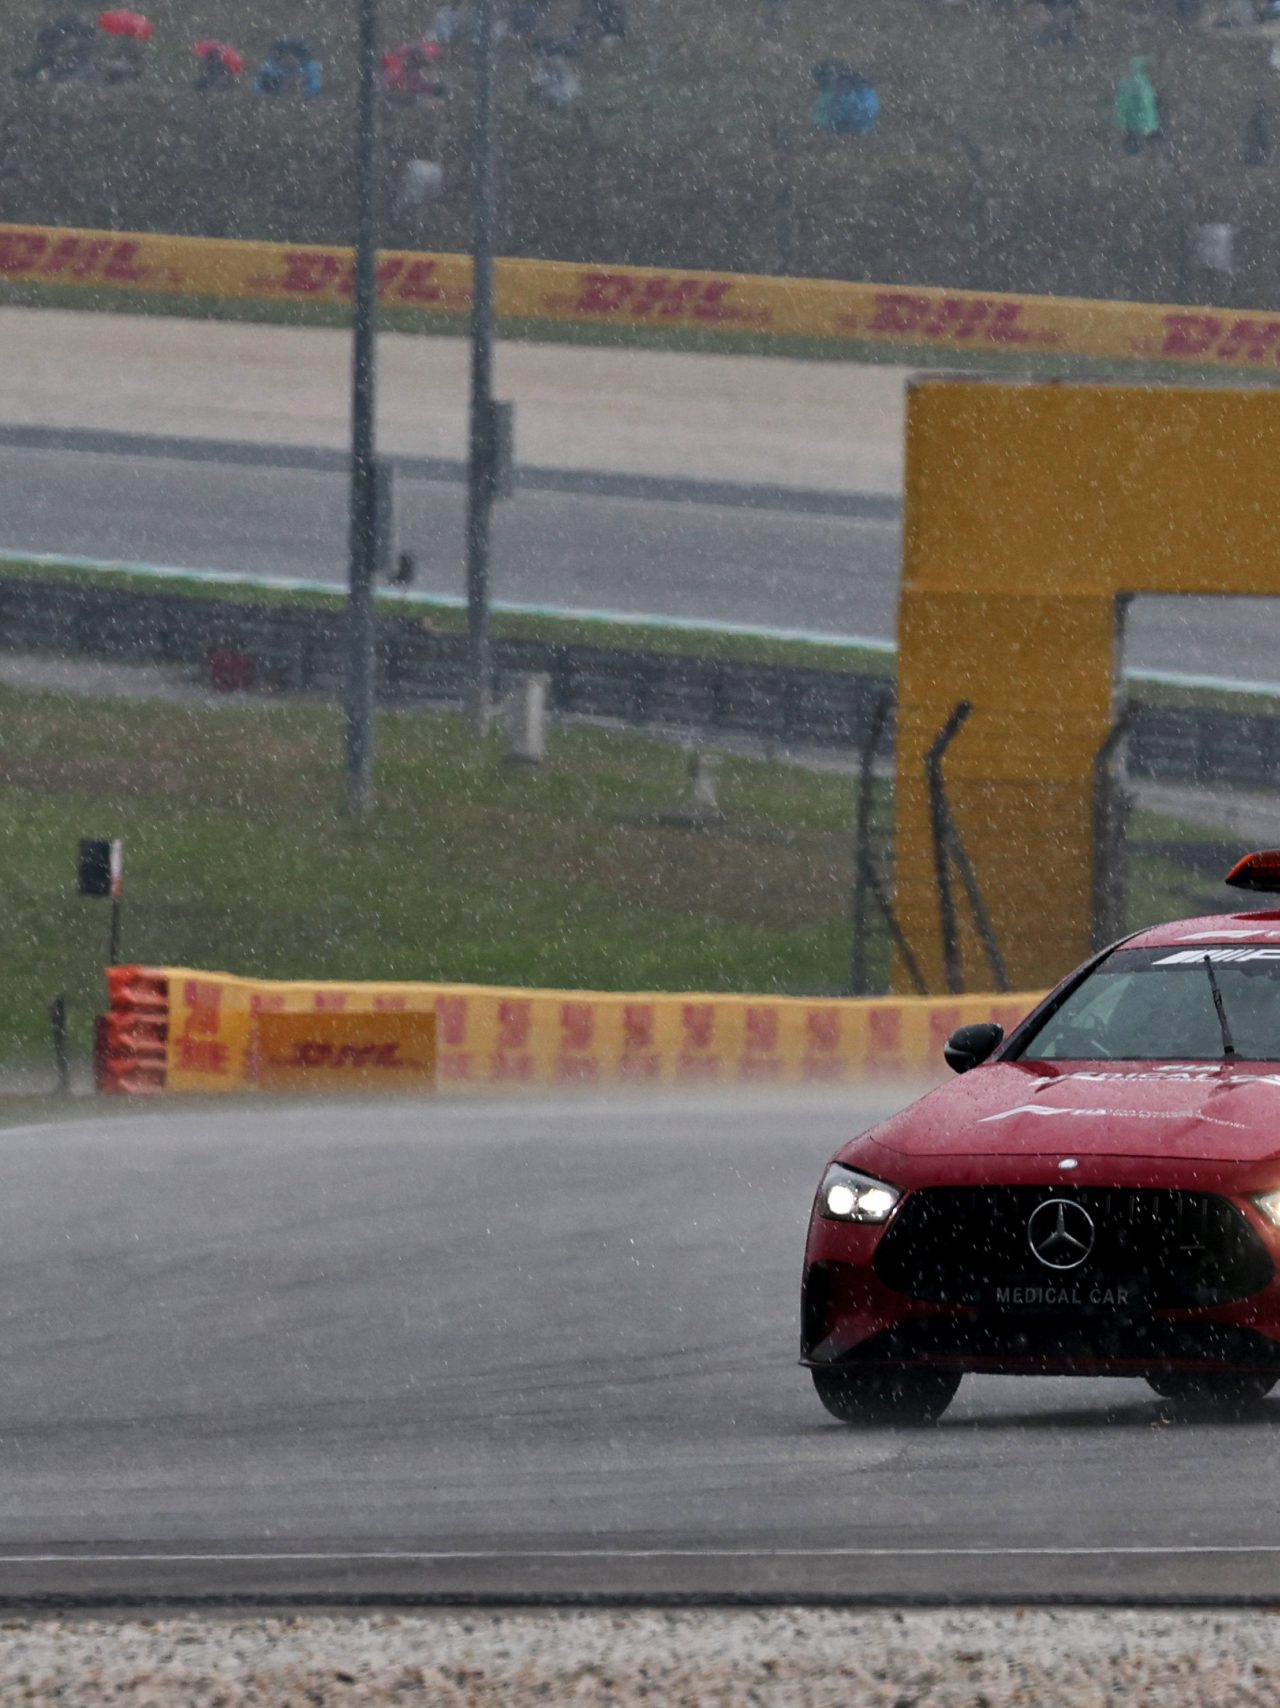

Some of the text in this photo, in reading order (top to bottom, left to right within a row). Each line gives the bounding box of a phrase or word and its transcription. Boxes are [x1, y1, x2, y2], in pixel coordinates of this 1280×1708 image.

[576, 272, 740, 323] DHL
[867, 293, 1030, 344] DHL
[995, 1286, 1129, 1305] MEDICAL CAR
